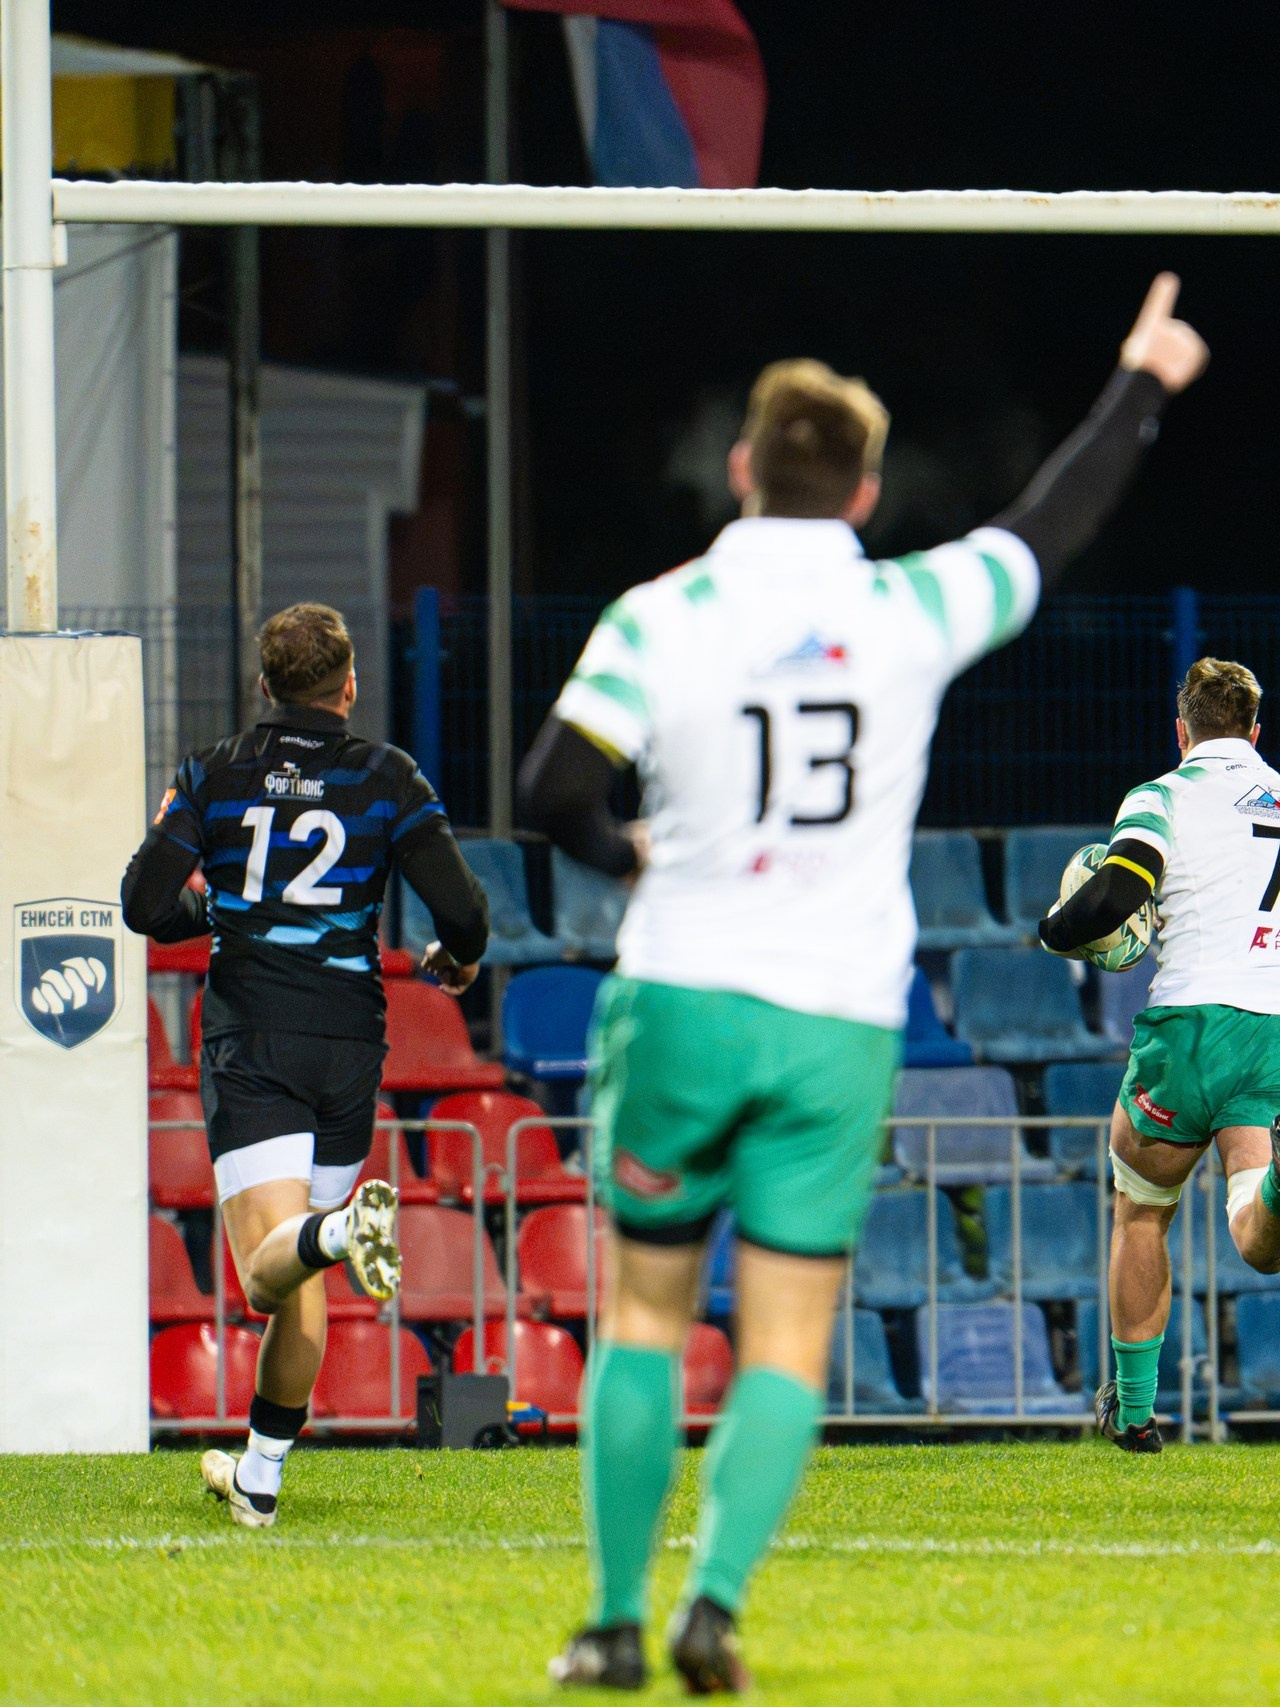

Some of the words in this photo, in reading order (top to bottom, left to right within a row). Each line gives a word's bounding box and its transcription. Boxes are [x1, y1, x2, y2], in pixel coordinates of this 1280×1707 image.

[265, 774, 325, 798] ФОРТНОКС
[740, 703, 860, 825] 13
[241, 806, 346, 906] 12
[21, 906, 74, 928] ЕНИСЕЙ
[80, 910, 113, 927] СТМ
